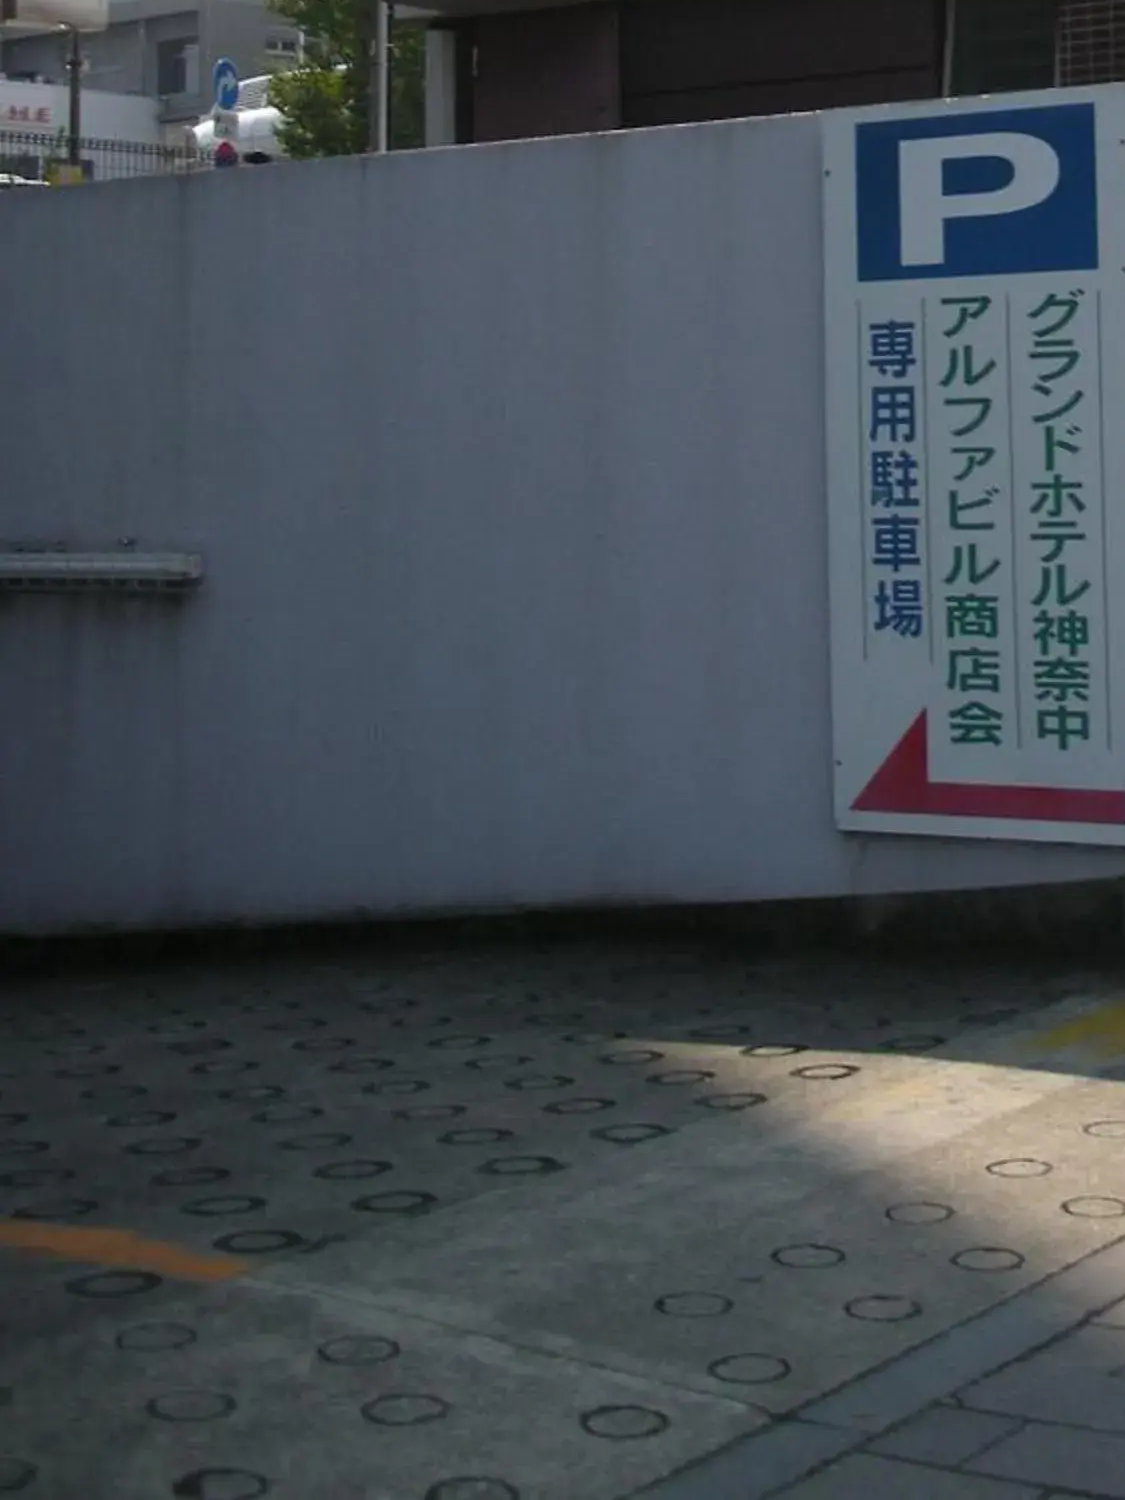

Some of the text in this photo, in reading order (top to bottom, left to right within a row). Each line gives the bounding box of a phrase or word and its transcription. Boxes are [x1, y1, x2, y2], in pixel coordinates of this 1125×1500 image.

[899, 131, 1060, 267] P
[867, 320, 923, 639] 専用駐車場
[939, 295, 1002, 748] アルファビル商店会
[1028, 288, 1092, 751] グランドホテル神奈中
